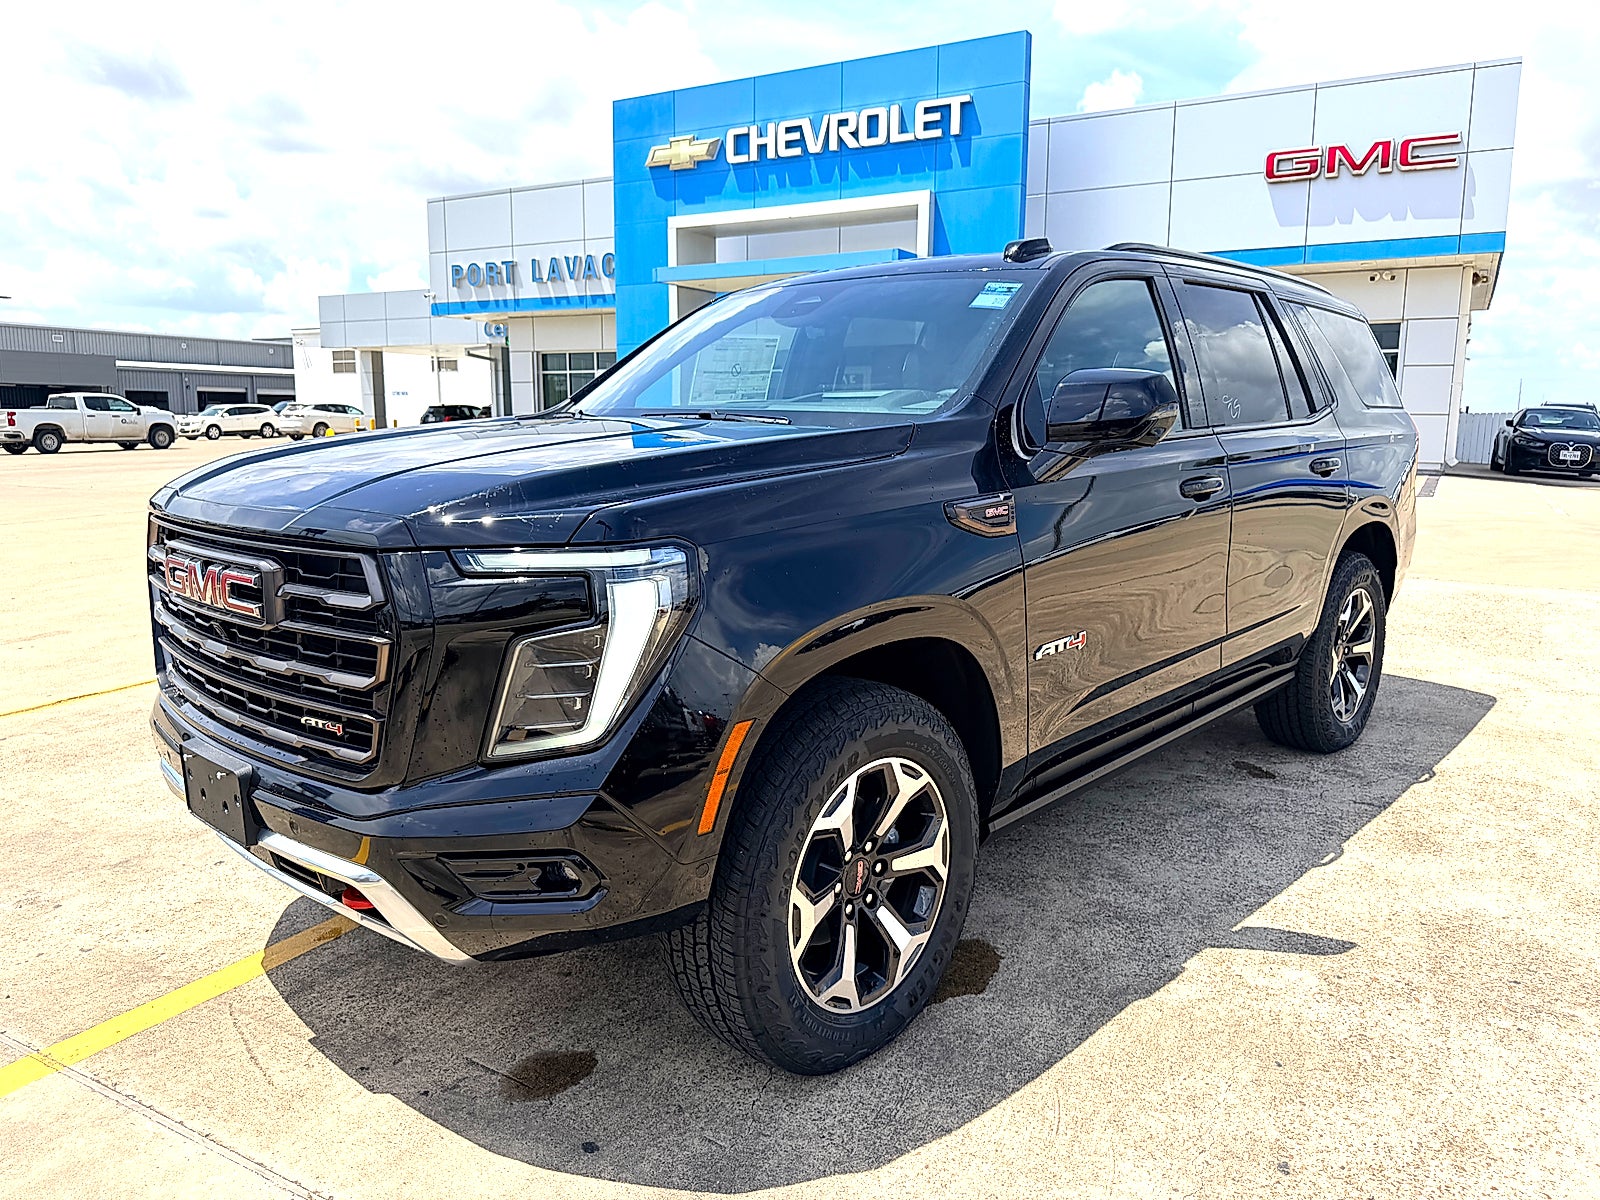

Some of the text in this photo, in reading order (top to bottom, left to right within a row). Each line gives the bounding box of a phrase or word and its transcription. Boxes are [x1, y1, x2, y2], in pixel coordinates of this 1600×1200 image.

[725, 94, 972, 164] CHEVROLET
[1264, 131, 1463, 184] GMC
[451, 260, 515, 288] PORT
[984, 505, 1009, 518] GMC
[165, 553, 263, 618] GMC
[1033, 630, 1087, 661] AT4
[301, 716, 343, 736] AT4
[854, 860, 864, 895] GMC
